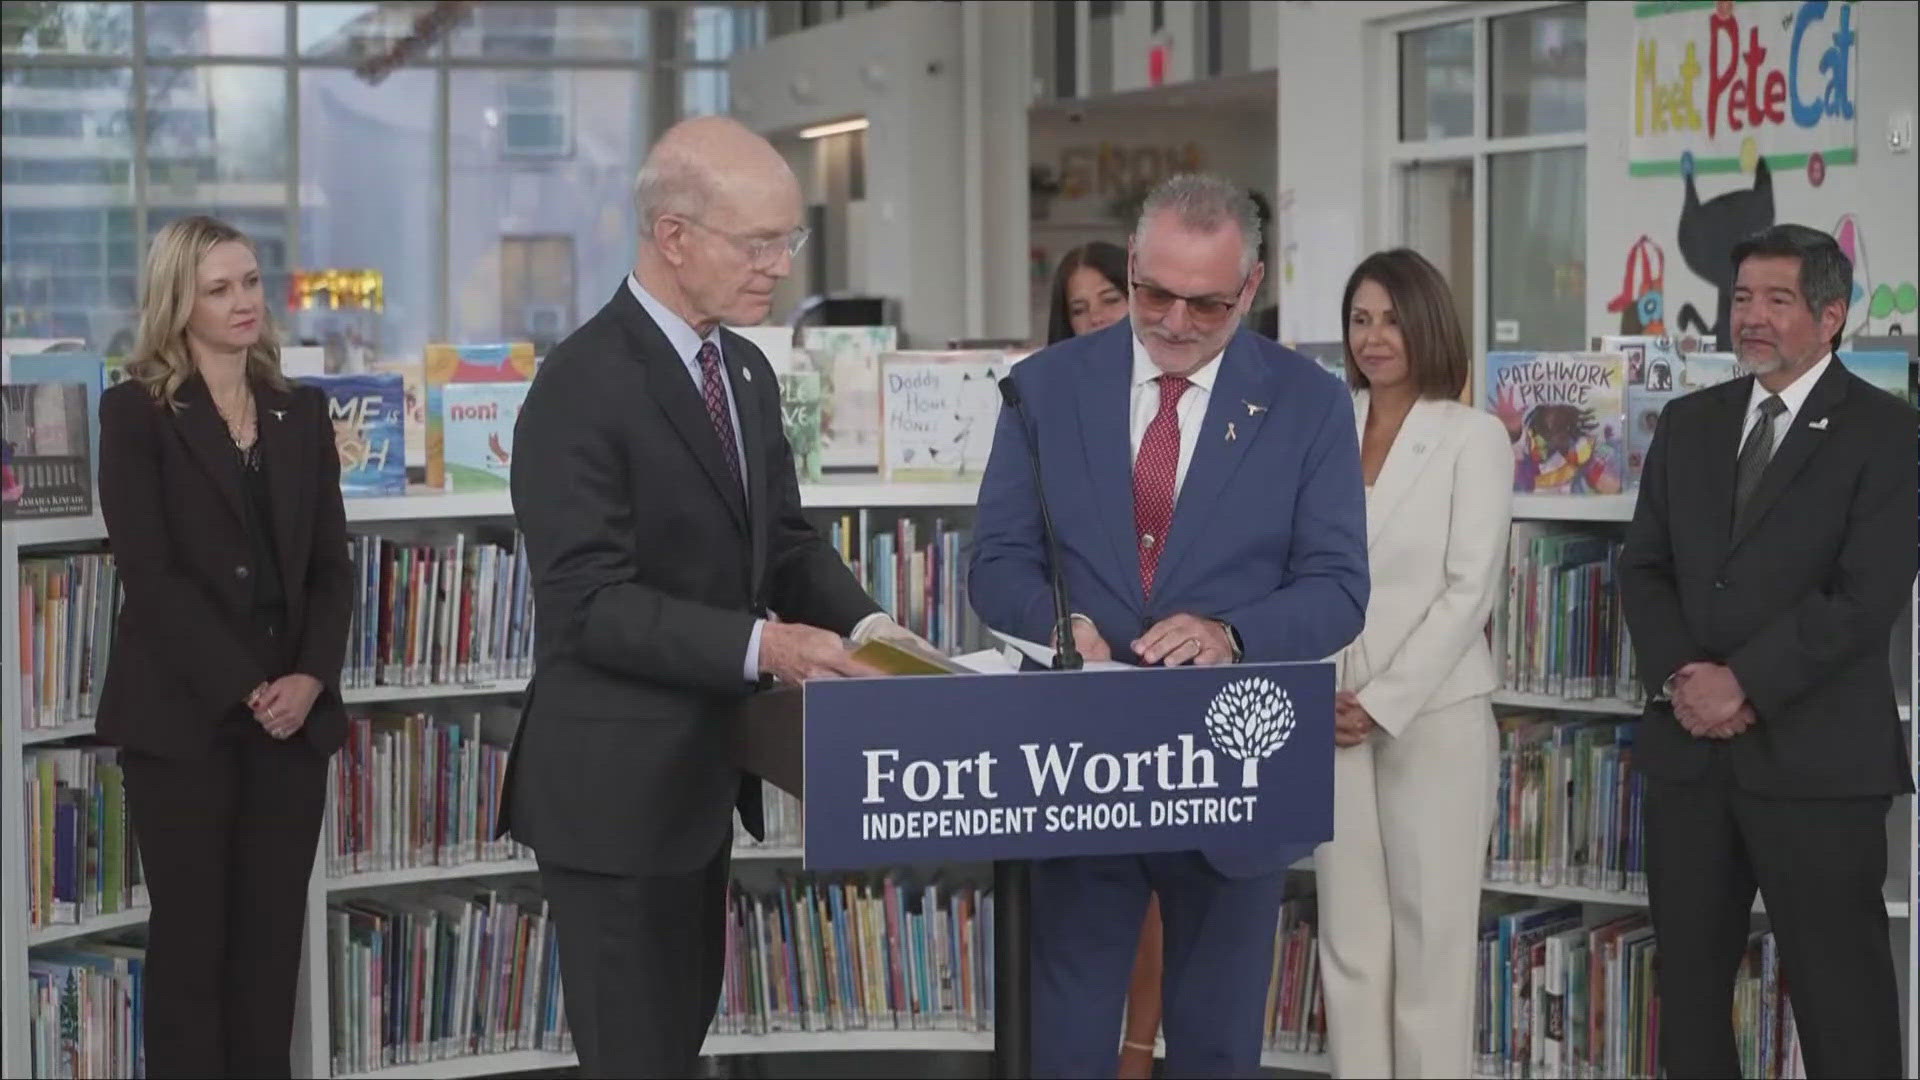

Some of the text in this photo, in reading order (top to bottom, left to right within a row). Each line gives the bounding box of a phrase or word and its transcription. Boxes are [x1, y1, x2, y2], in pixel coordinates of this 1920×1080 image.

[1635, 38, 1702, 137] Meet
[1707, 12, 1786, 141] Pete
[1789, 1, 1855, 128] Cat
[1497, 359, 1616, 389] PATCHWORK
[451, 402, 498, 421] noni
[1519, 384, 1594, 406] PRINCE
[328, 396, 383, 430] ME
[862, 733, 1219, 804] Fort Worth
[862, 795, 1258, 840] INDEPENDENT SCHOOL DISTRICT
